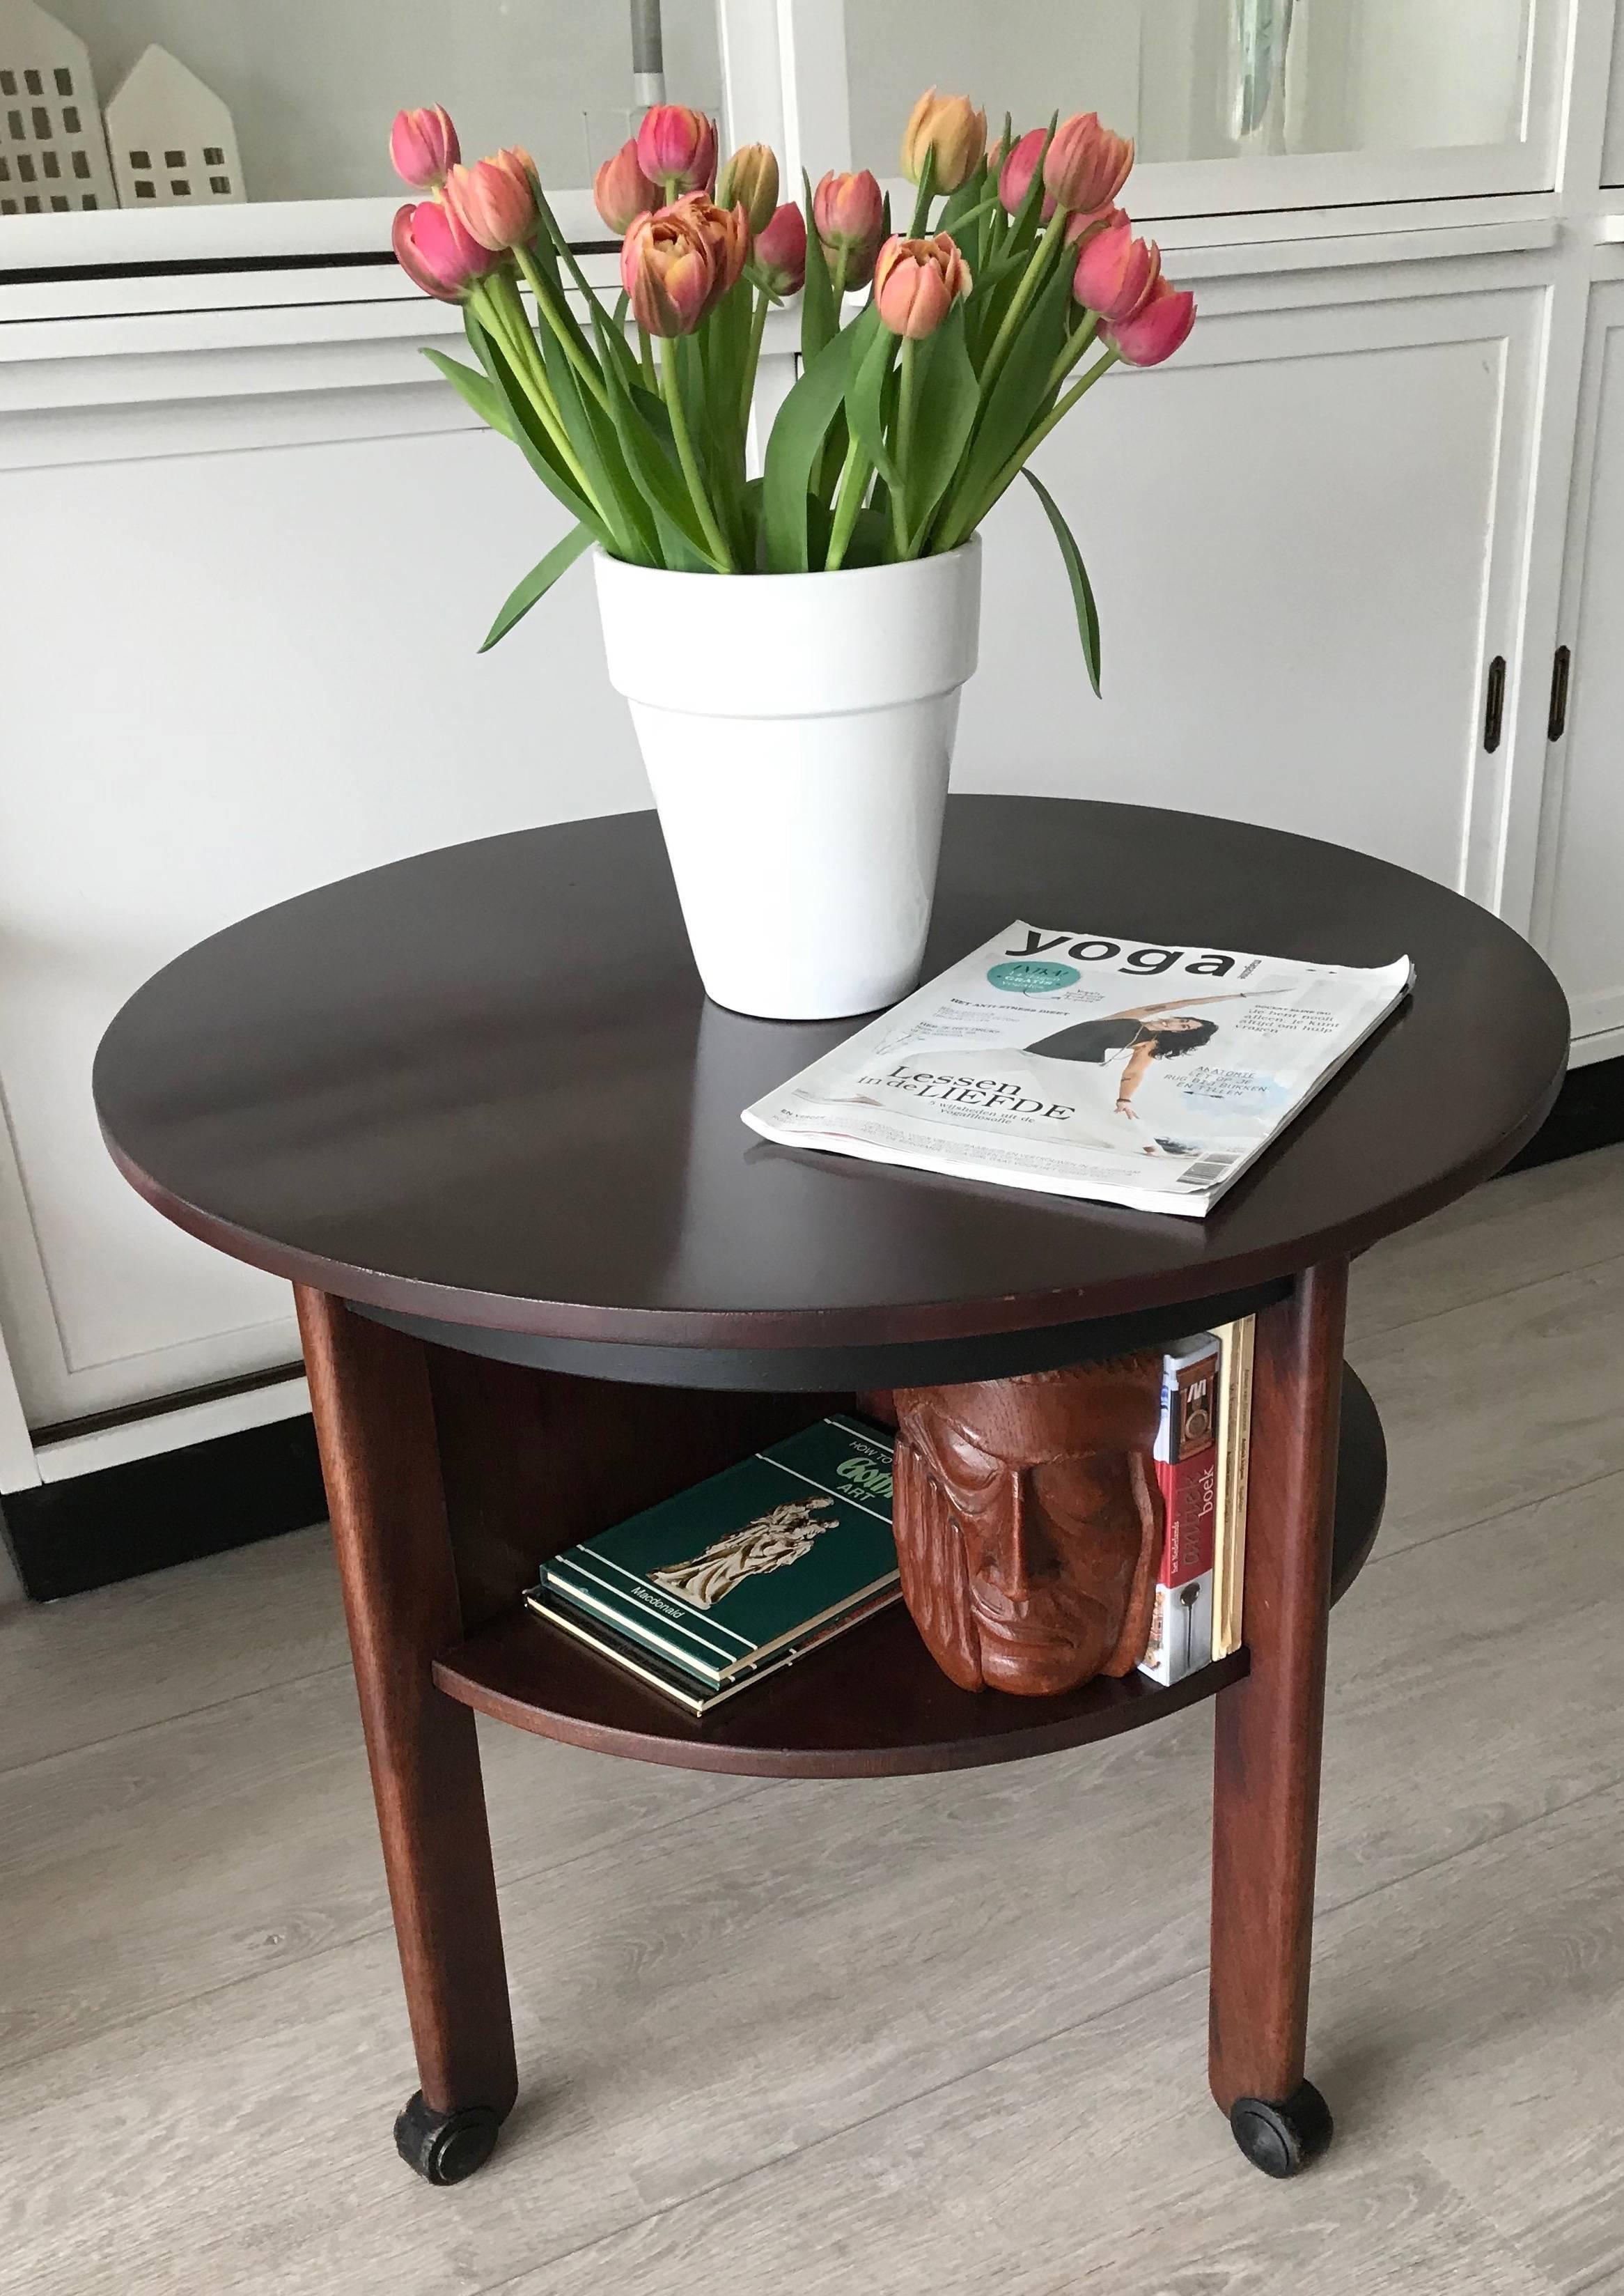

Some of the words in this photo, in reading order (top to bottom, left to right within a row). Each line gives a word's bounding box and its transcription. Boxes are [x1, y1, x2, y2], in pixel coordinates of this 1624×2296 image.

[1004, 930, 1236, 977] yoga
[1302, 1025, 1333, 1034] hulp
[887, 1065, 1022, 1096] Lessen
[1196, 1066, 1256, 1079] ANATOMIE
[858, 1075, 882, 1085] in
[887, 1079, 917, 1092] de
[914, 1084, 1076, 1121] LIEFDE
[1199, 1085, 1243, 1096] TILLEN
[939, 1102, 997, 1117] wijsheden
[850, 1441, 877, 1456] HOW
[877, 1453, 893, 1464] TO
[837, 1484, 875, 1501] ART
[1197, 1464, 1215, 1518] boek
[1171, 1521, 1180, 1561] Nederlands
[1171, 1560, 1179, 1574] het
[630, 1586, 685, 1619] Macdonald
